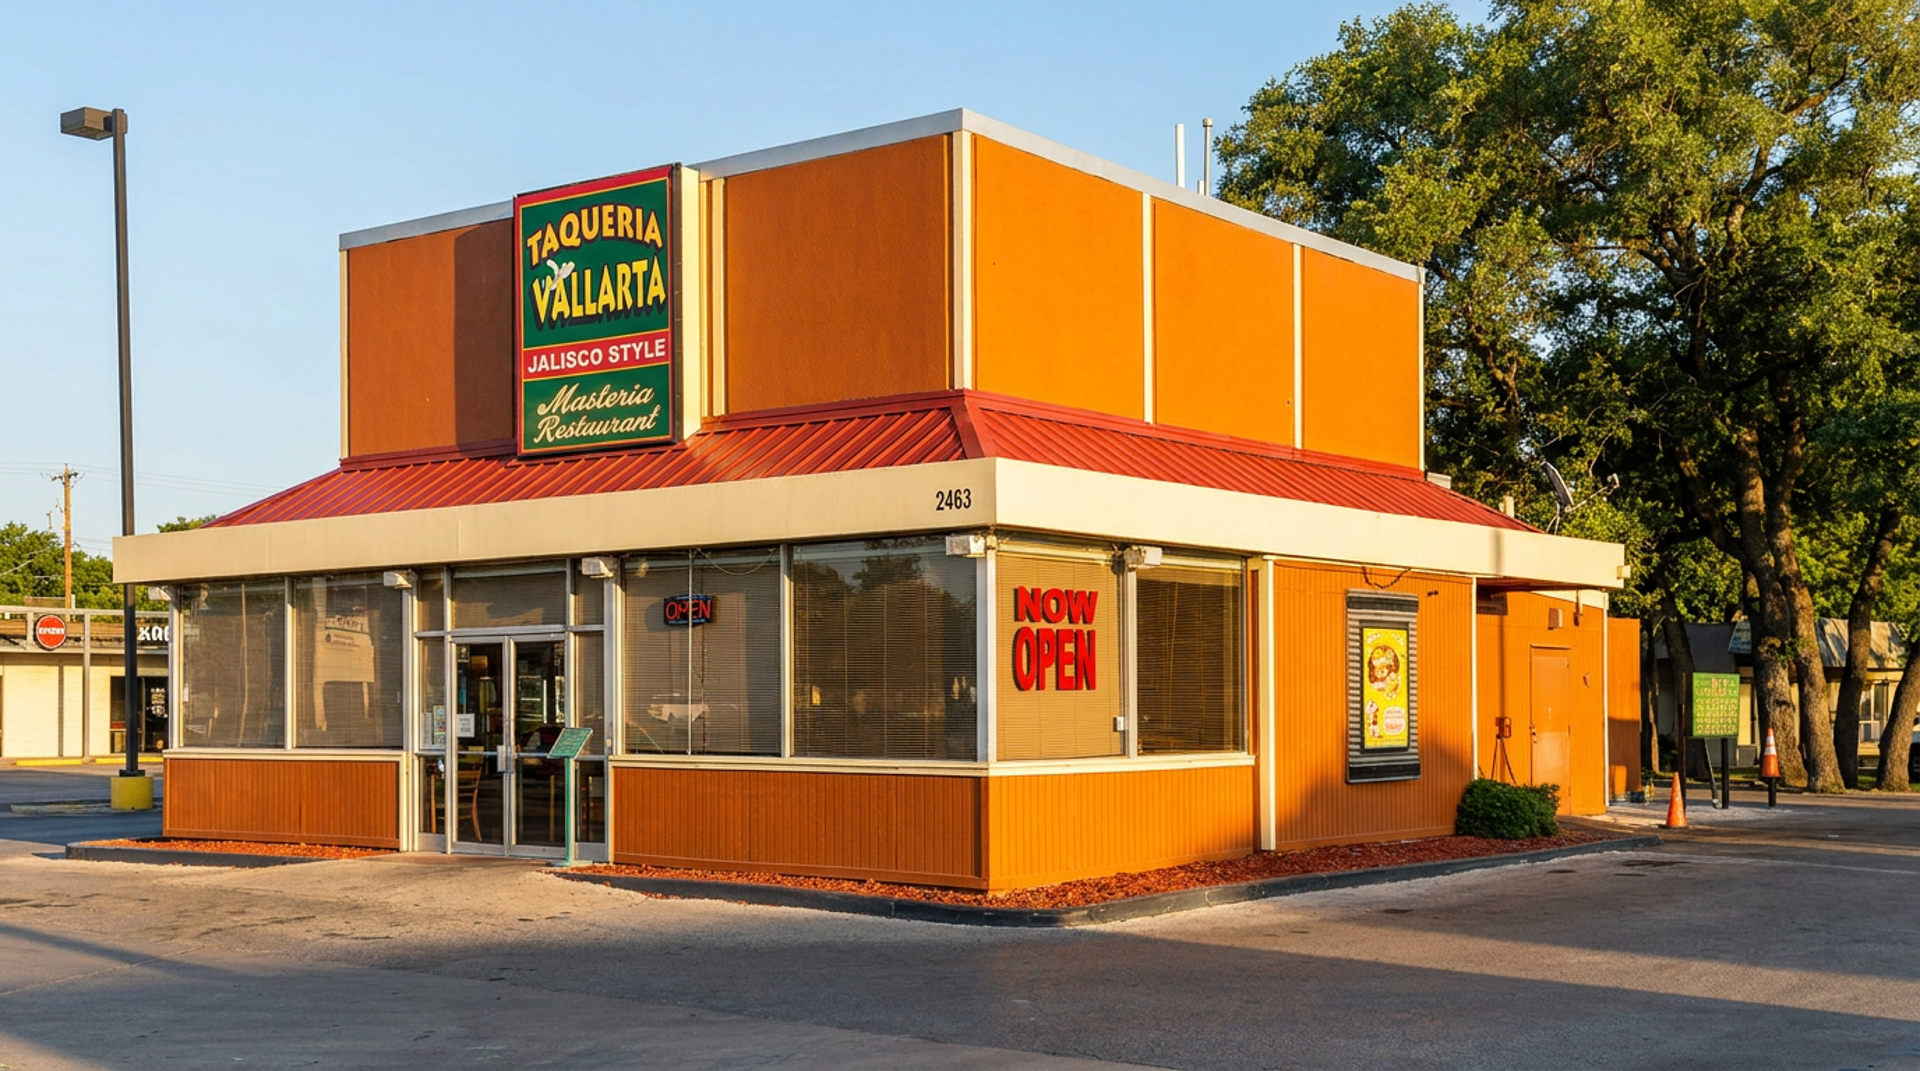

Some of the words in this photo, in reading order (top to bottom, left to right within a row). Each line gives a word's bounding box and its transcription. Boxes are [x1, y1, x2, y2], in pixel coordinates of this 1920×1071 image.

[527, 204, 663, 266] TAQUERIA
[532, 255, 667, 324] VALLARTA
[527, 347, 603, 373] JALISCO
[608, 338, 666, 363] STYLE
[533, 404, 661, 443] Restaurant
[936, 488, 972, 511] 2463
[666, 599, 711, 620] OPEN
[1014, 585, 1098, 624] NOW
[1012, 626, 1097, 691] OPEN
